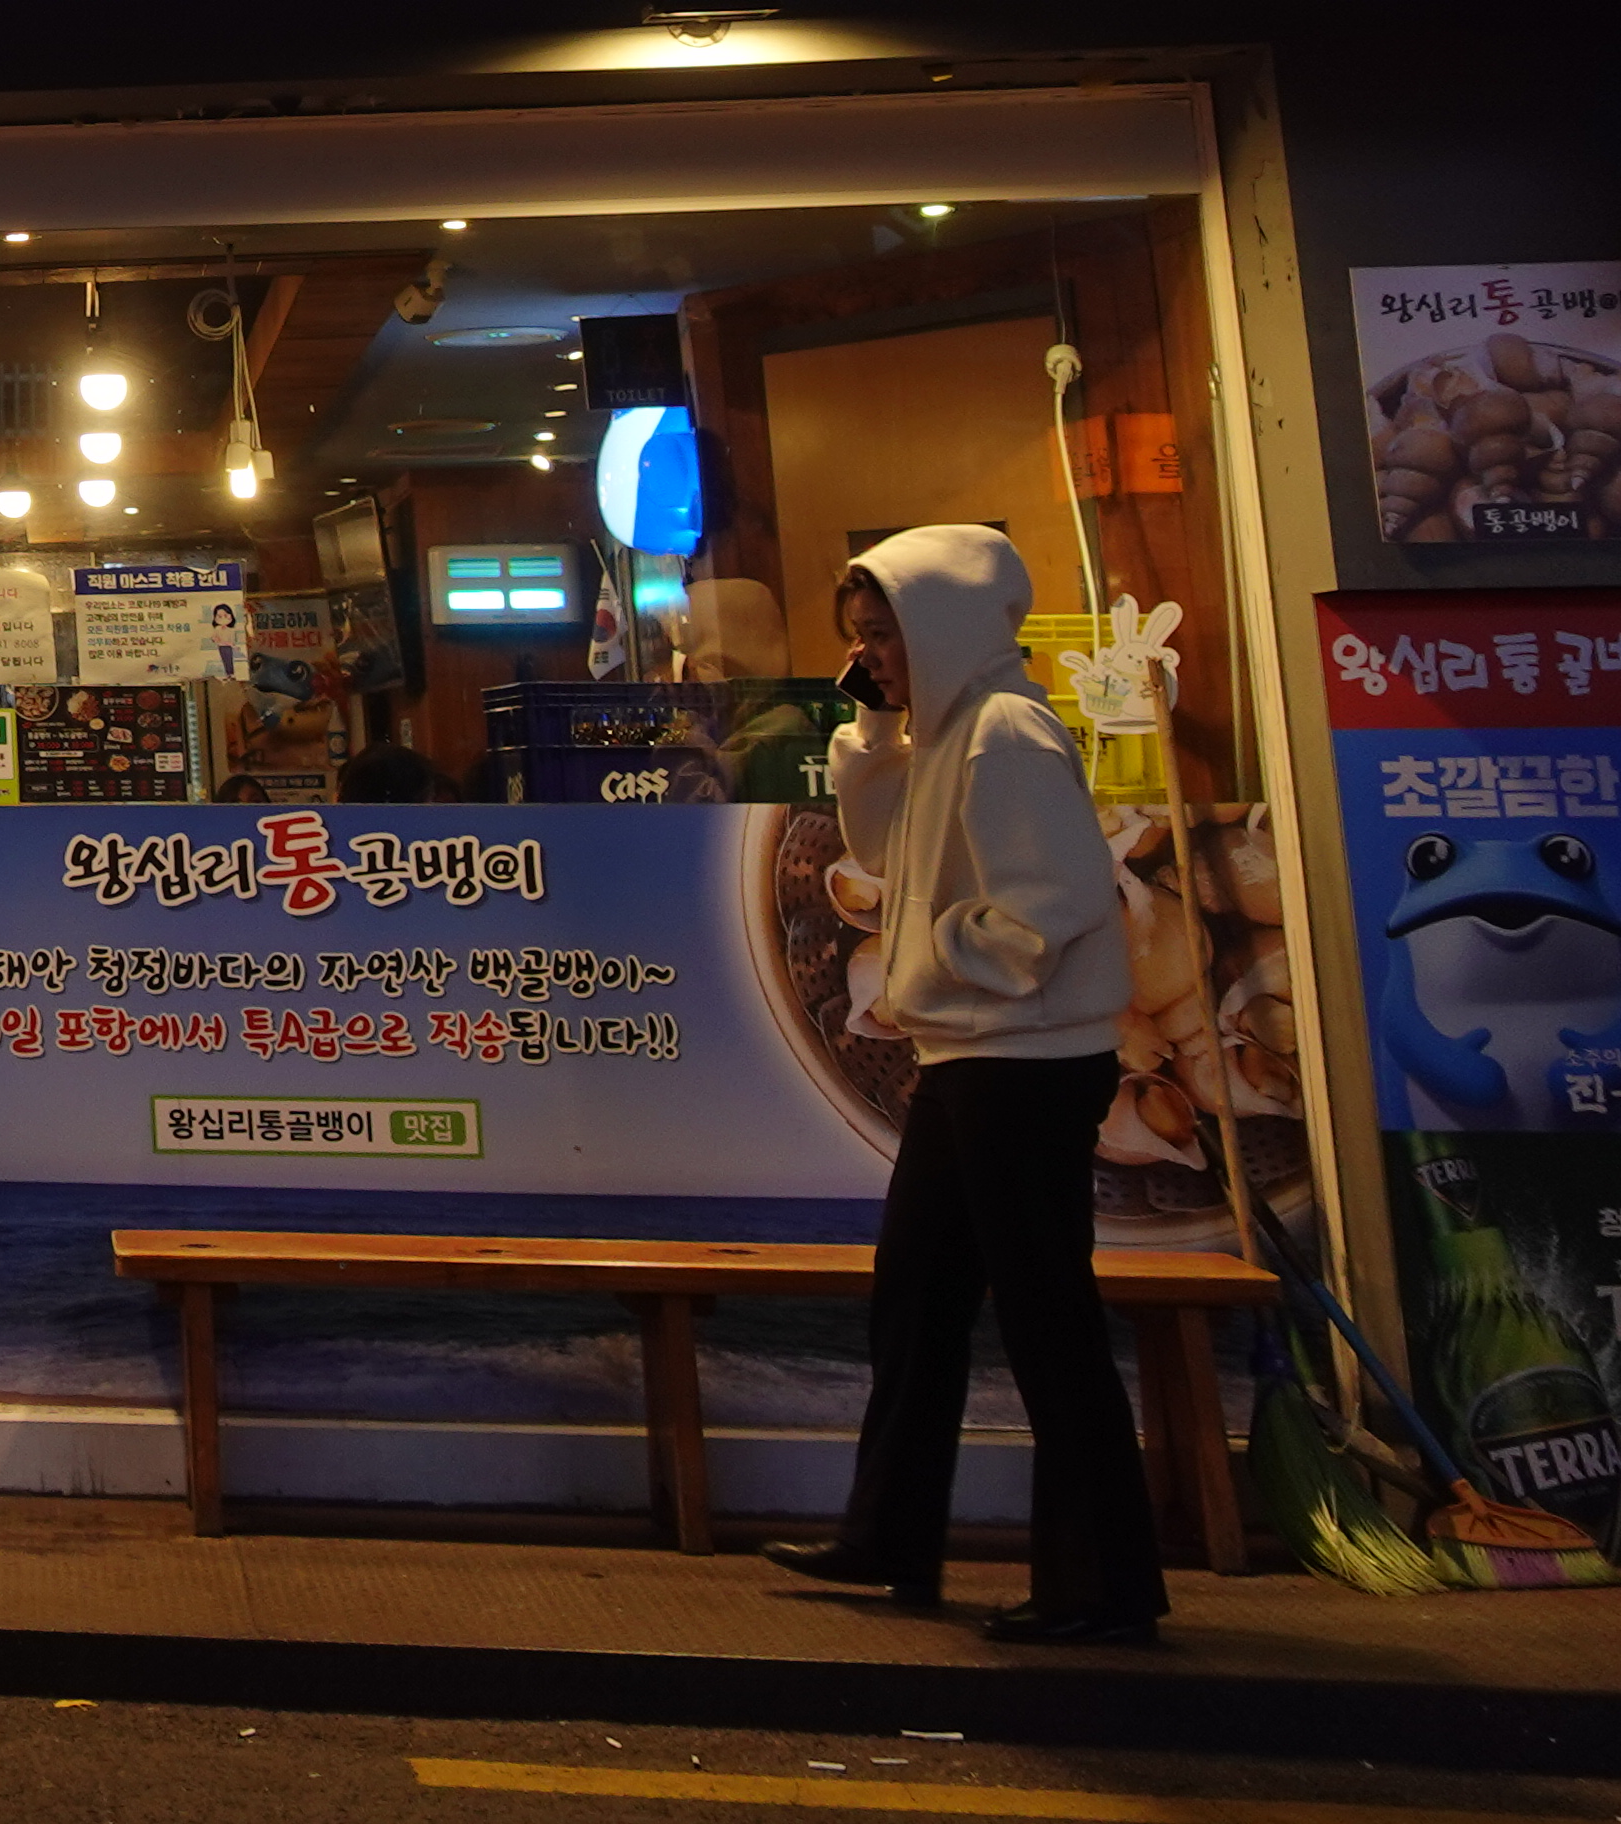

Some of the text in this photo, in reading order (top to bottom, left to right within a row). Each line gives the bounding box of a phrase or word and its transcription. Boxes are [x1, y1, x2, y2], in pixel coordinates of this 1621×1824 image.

[605, 387, 667, 403] TOILET
[1484, 507, 1581, 533] 통골뱅이
[87, 573, 117, 590] 직원
[120, 572, 163, 589] 마스크
[165, 570, 196, 588] 착용
[86, 946, 305, 997] 청정바다의
[317, 947, 459, 995] 자연산
[55, 1006, 229, 1056] 포항에서
[240, 1006, 417, 1064] 특A급으로
[428, 1008, 680, 1064] 직송됩니다!!
[1564, 1072, 1621, 1114] 진
[166, 1107, 454, 1143] 왕십리통골뱅이 맛집
[1490, 1418, 1621, 1499] TERRA
